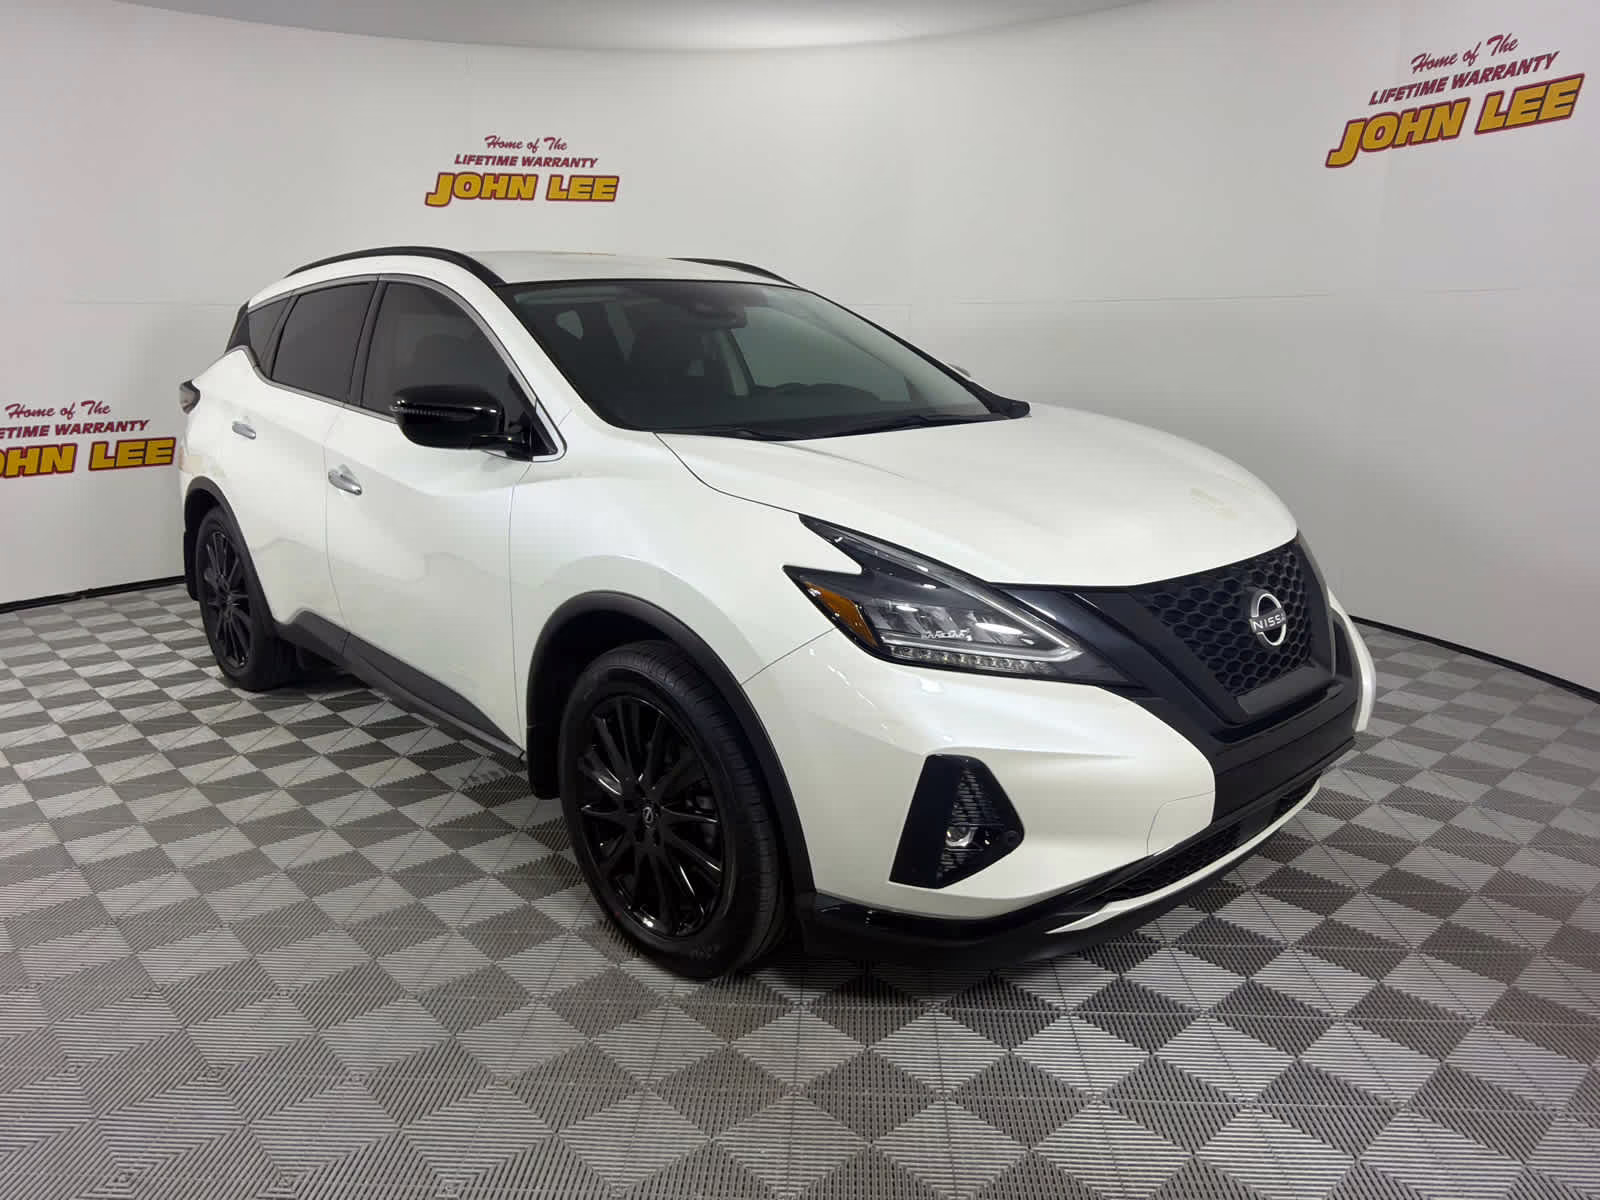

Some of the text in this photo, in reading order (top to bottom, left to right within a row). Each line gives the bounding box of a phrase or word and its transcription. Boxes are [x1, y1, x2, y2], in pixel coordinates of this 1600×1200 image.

[1411, 33, 1518, 74] Home of The
[1368, 51, 1560, 106] LIFETIME WARRANTY
[1325, 73, 1585, 168] JOHN LEE
[454, 154, 598, 168] LIFETIME WARRANTY
[484, 135, 567, 153] Home of The
[425, 172, 619, 207] JOHN LEE
[5, 400, 111, 420] Home of The
[0, 419, 150, 439] ETIME WARRANTY
[0, 437, 176, 478] HN LEE
